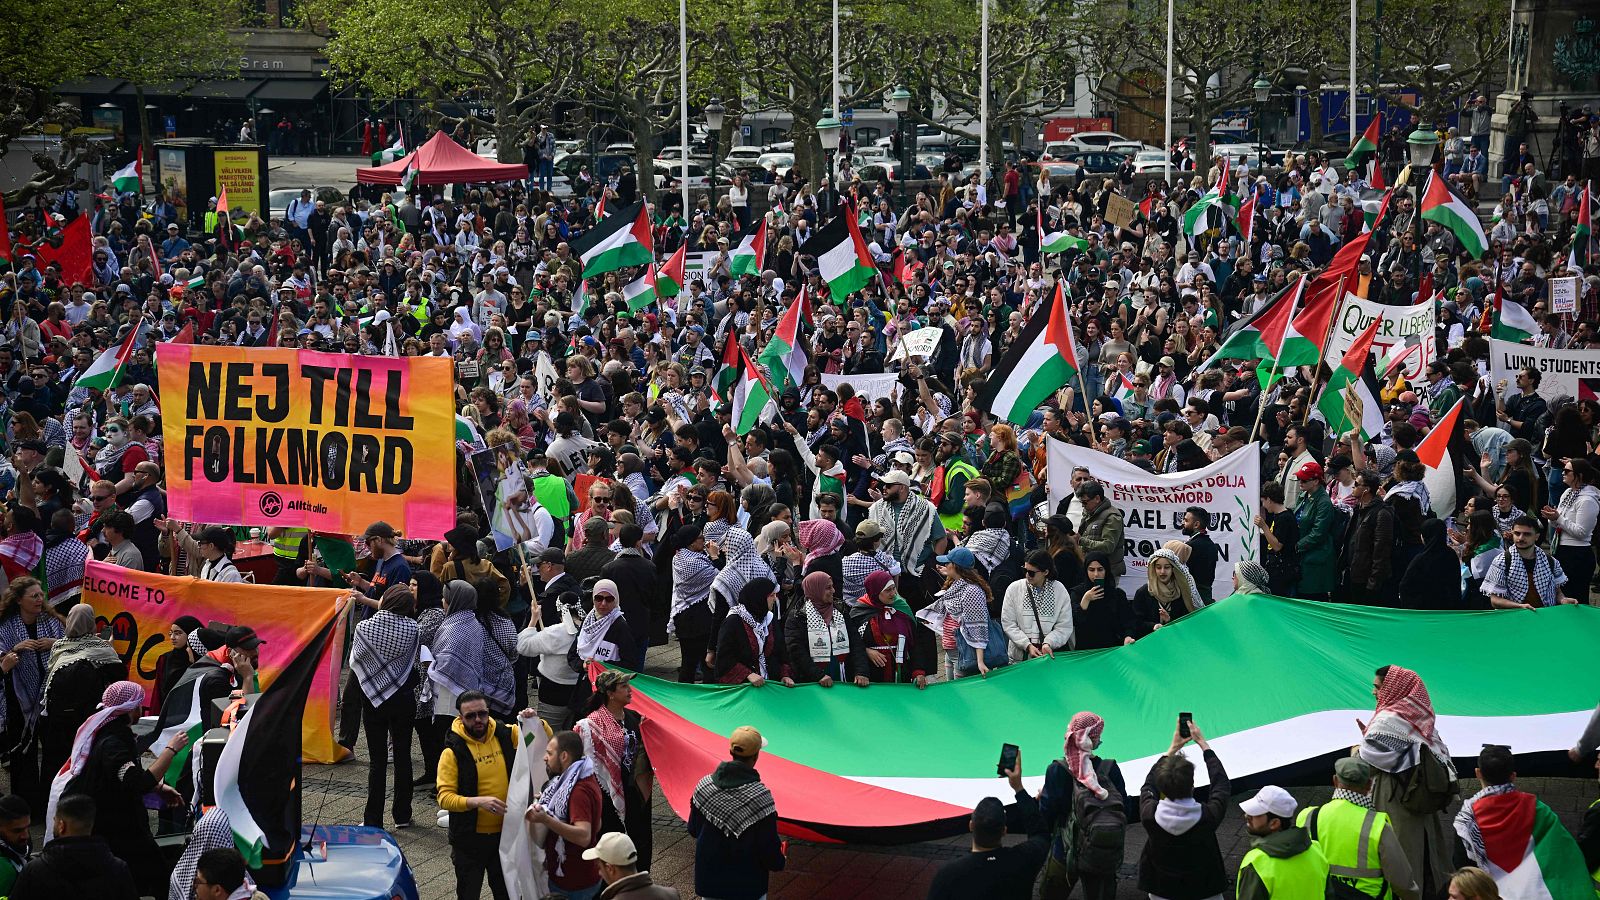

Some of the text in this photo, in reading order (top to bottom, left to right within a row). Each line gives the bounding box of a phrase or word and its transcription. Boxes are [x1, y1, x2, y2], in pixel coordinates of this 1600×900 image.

[683, 271, 704, 281] SION
[1504, 353, 1536, 371] LUND
[185, 361, 414, 430] NEJ TILL
[184, 424, 414, 495] FOLKMORD
[1113, 483, 1167, 494] GLITTER
[1170, 480, 1203, 493] KAN
[1206, 472, 1246, 489] DÖLJA
[1113, 490, 1213, 504] ETT FOLKMORD
[84, 576, 165, 604] ELCOME TO
[595, 646, 611, 658] NCE
